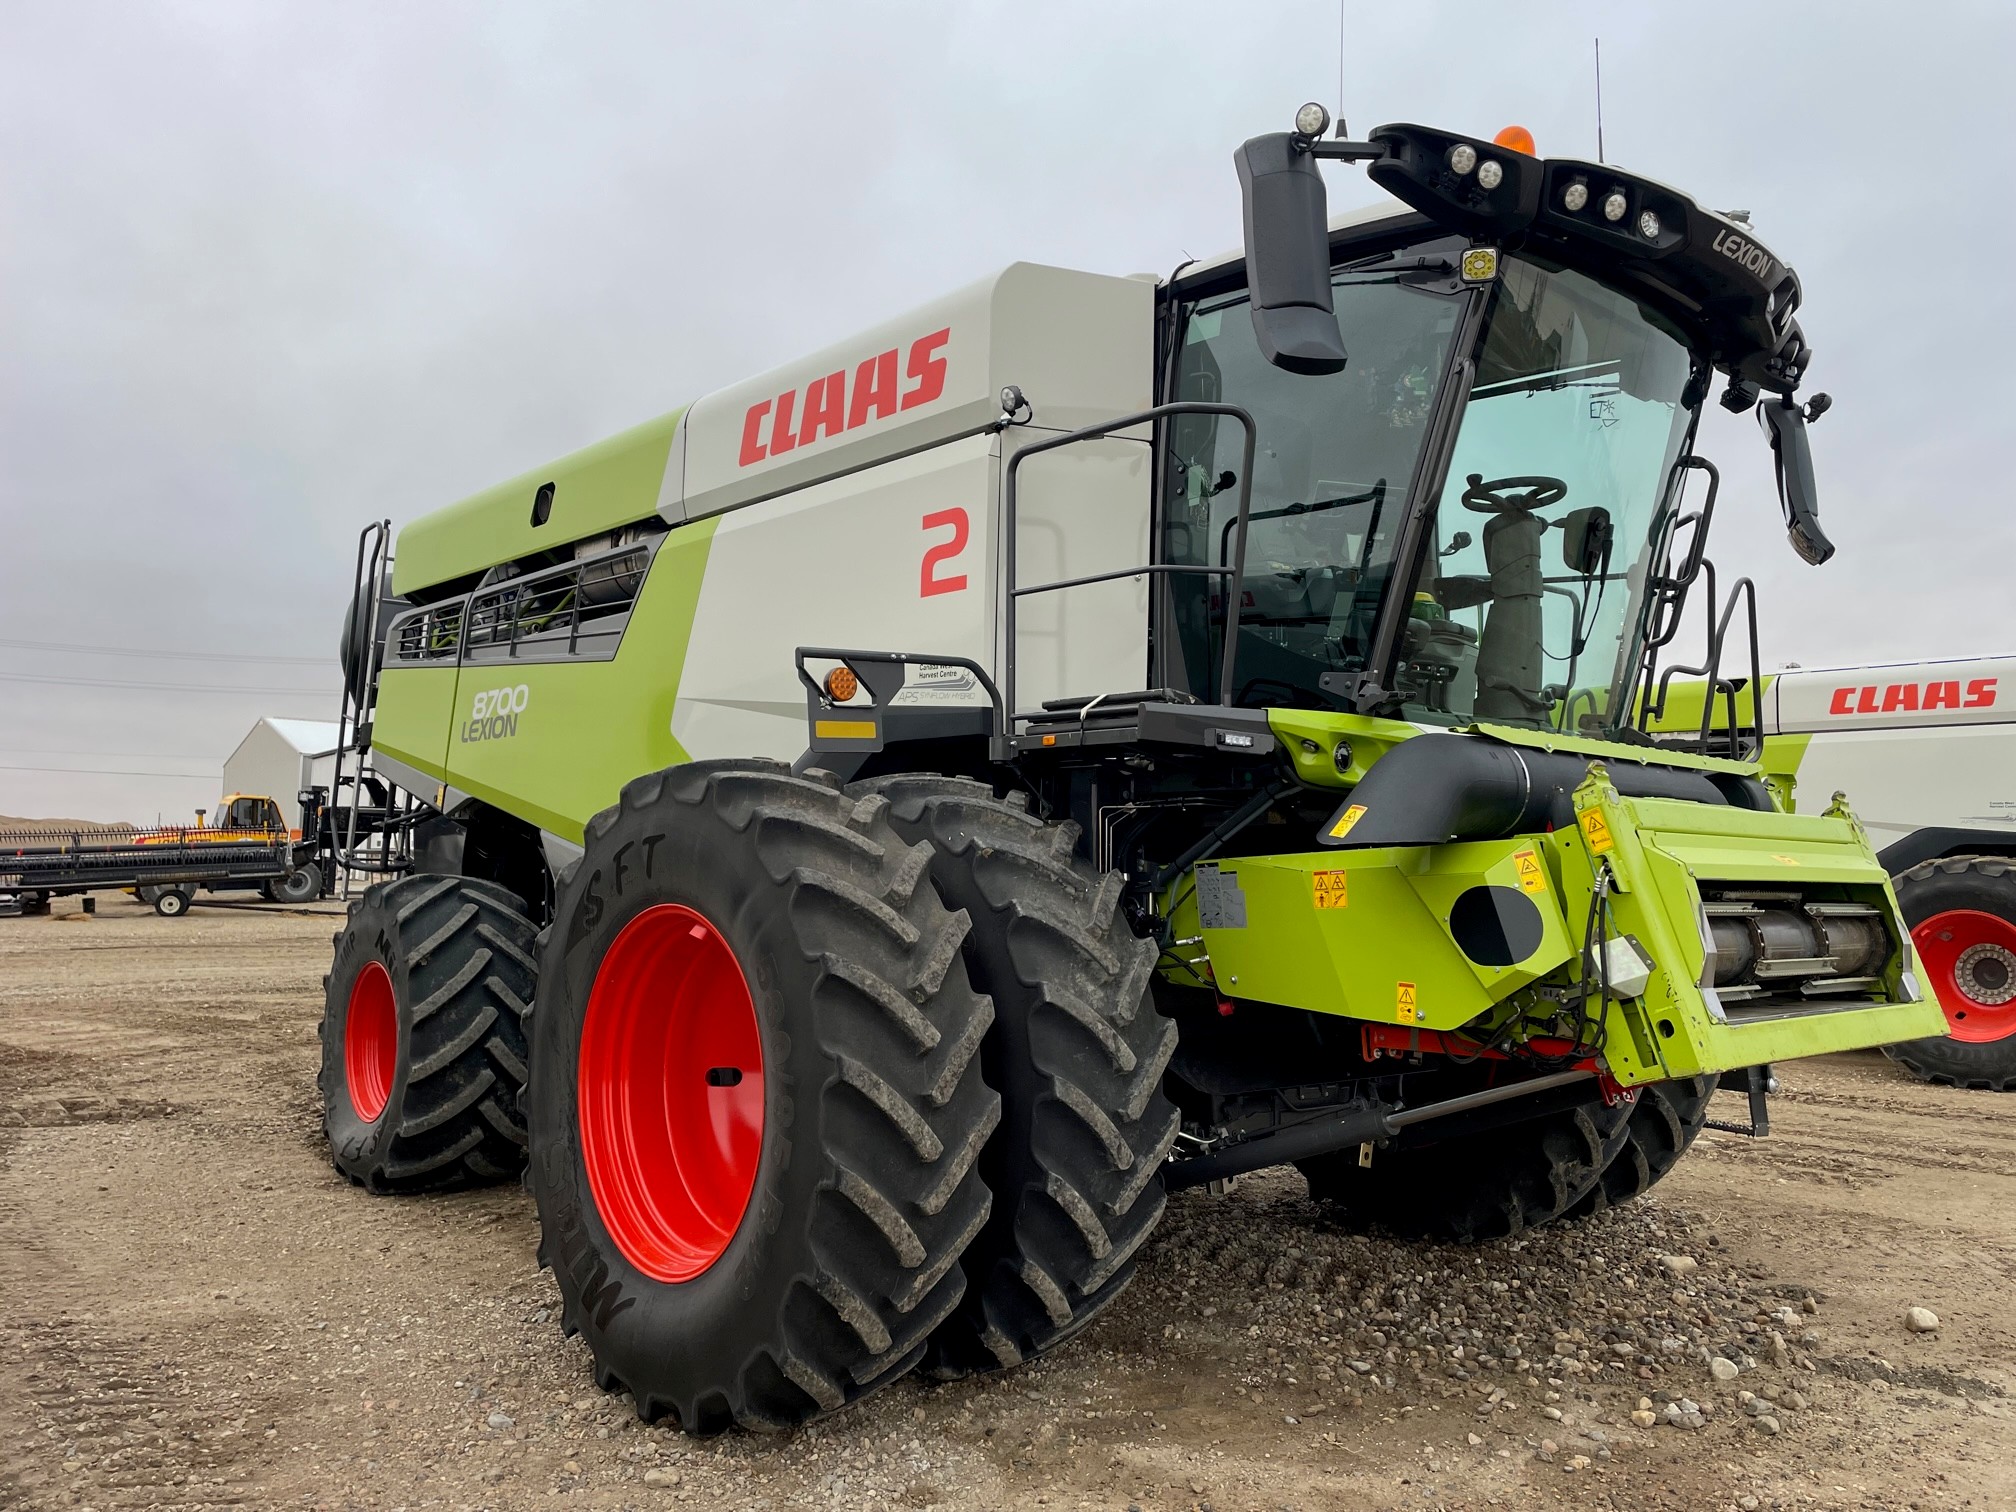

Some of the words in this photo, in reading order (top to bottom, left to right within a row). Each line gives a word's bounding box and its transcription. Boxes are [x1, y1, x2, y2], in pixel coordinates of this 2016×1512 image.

[1712, 228, 1773, 279] LEXION
[738, 326, 951, 468] CLAAS
[920, 506, 970, 599] 2
[939, 670, 958, 678] Centre
[472, 683, 529, 721] 8700
[897, 691, 919, 703] APS
[1829, 678, 1999, 716] CLAAS
[461, 713, 519, 744] LEXION
[583, 833, 666, 932] SFT
